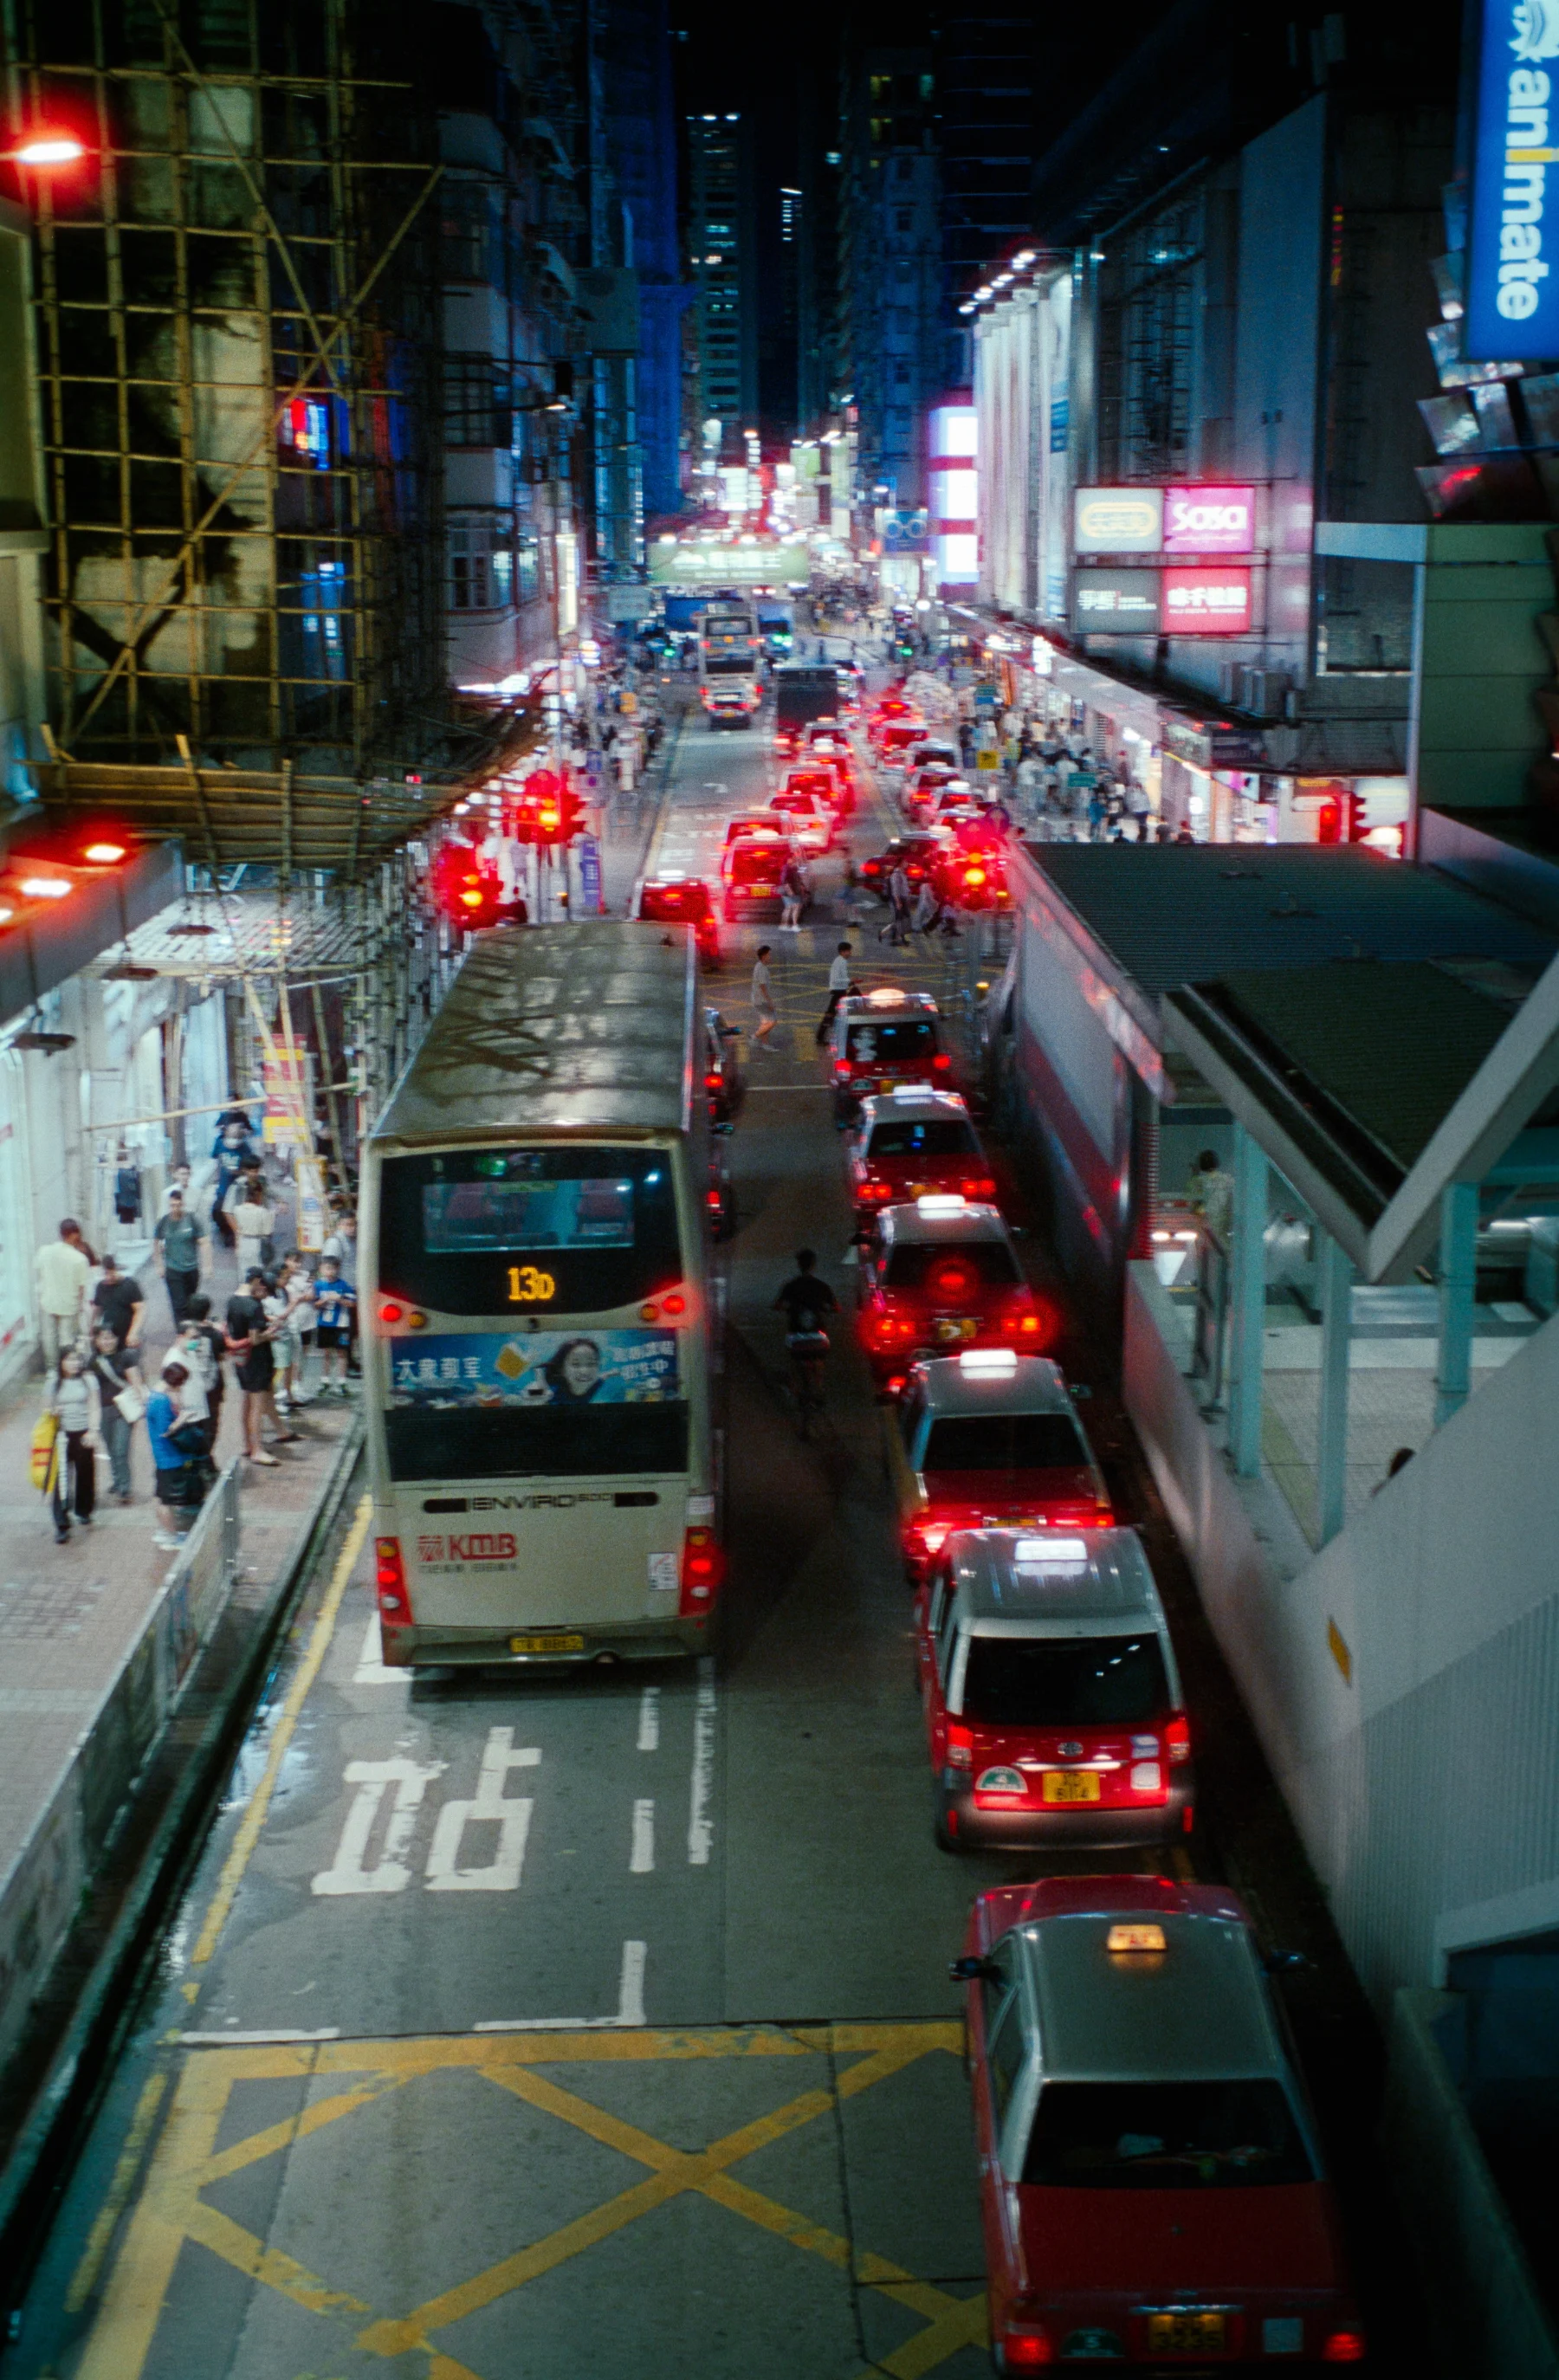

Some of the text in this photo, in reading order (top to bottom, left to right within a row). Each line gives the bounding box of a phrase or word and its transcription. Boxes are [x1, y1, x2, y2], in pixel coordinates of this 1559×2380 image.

[1496, 68, 1559, 320] animate
[508, 1267, 555, 1300] 13D
[448, 1532, 519, 1561] KMB
